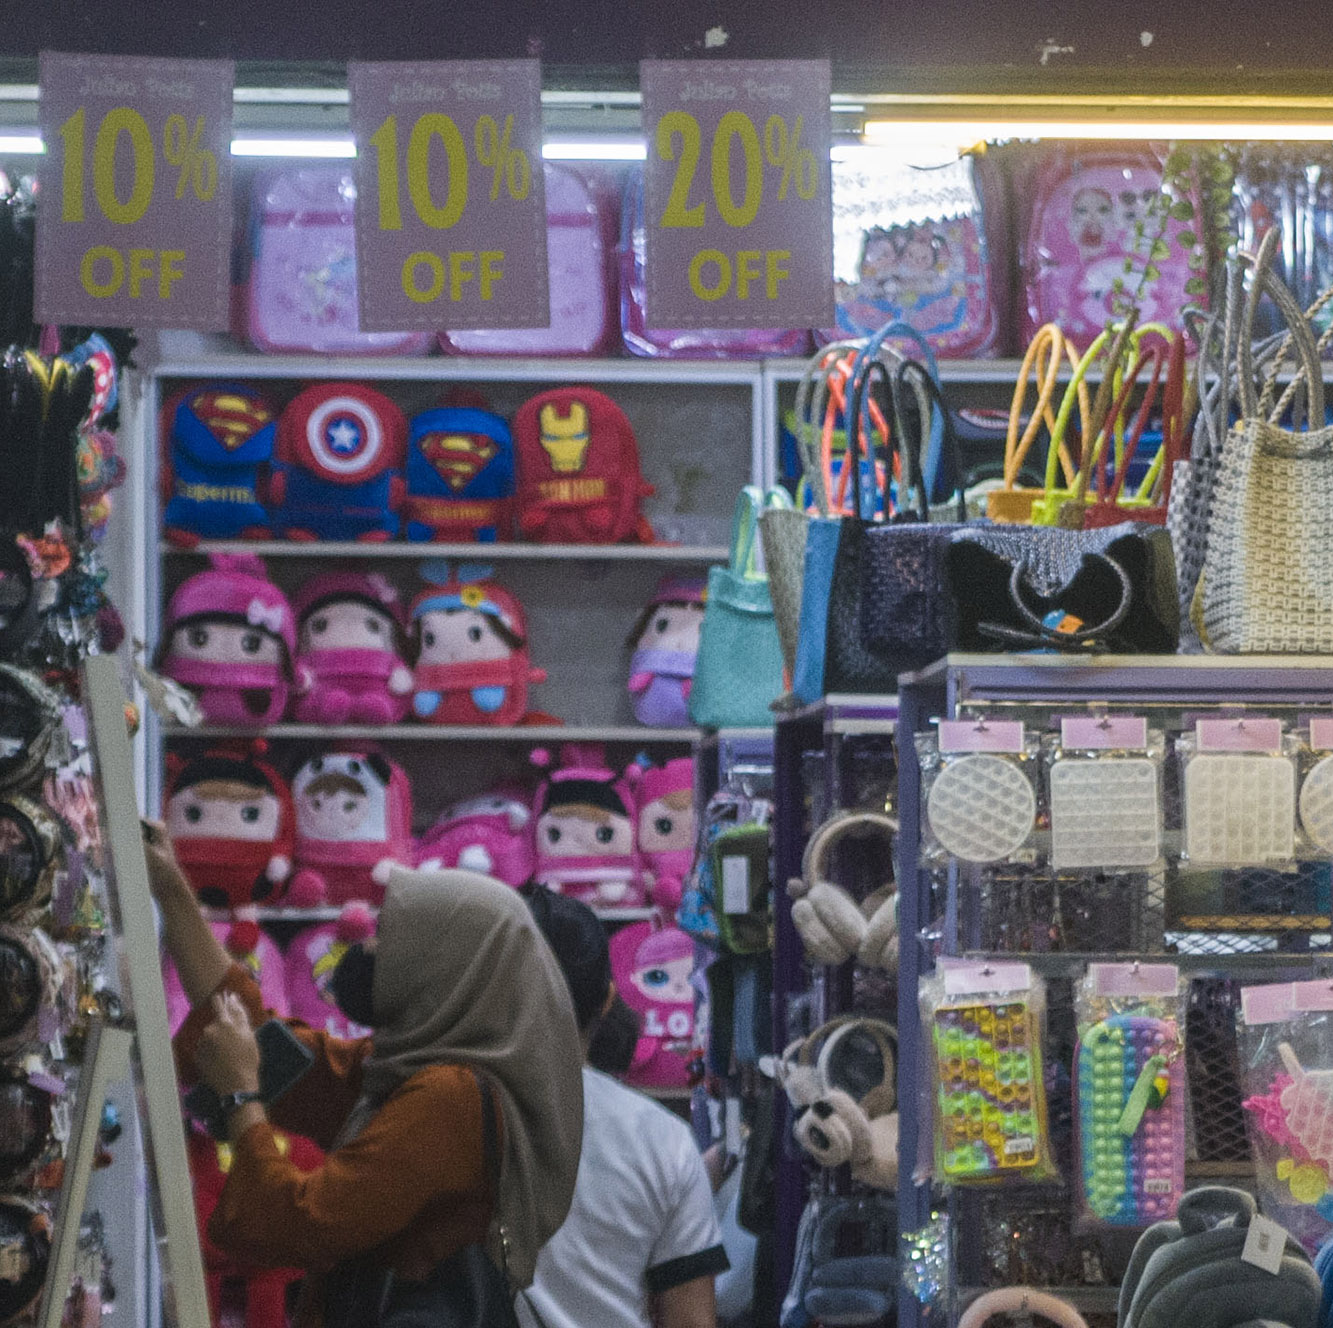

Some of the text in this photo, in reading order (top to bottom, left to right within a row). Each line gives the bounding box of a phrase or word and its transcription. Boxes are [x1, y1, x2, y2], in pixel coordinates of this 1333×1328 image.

[60, 106, 218, 224] 10%
[369, 112, 533, 231] 10%
[657, 110, 819, 228] 20%
[79, 244, 186, 299] OFF
[401, 251, 506, 304] OFF
[688, 248, 792, 301] OFF
